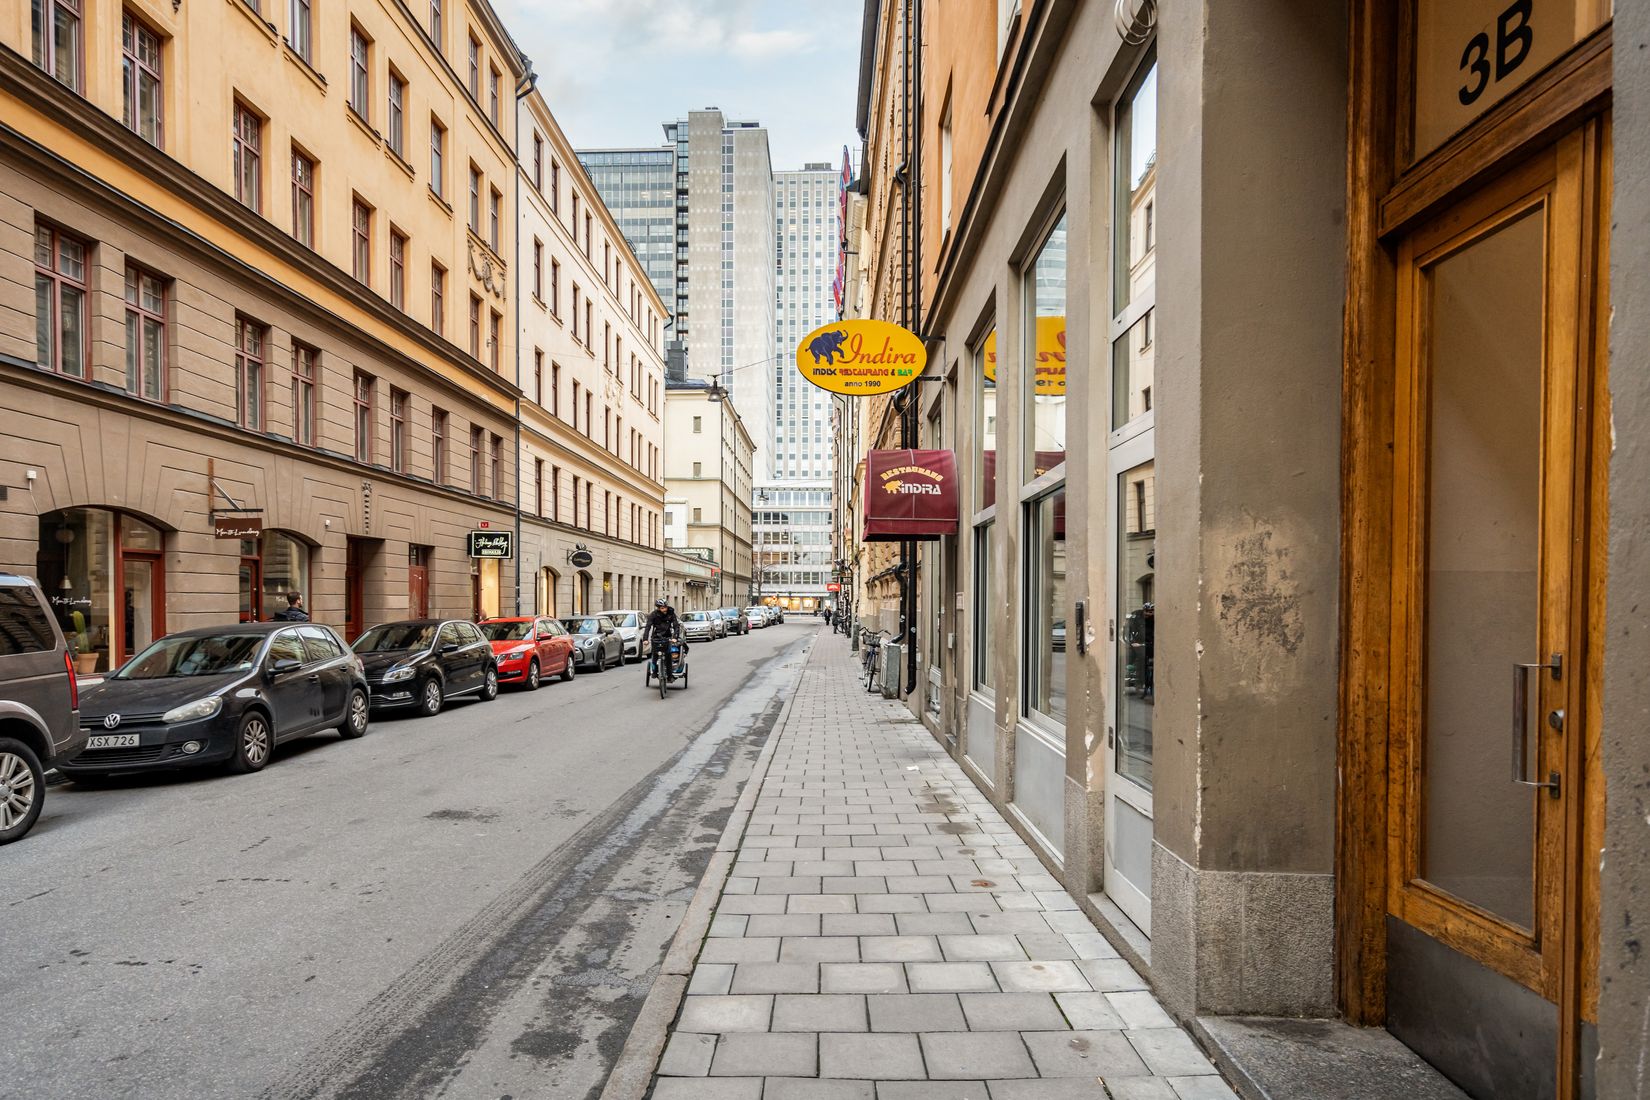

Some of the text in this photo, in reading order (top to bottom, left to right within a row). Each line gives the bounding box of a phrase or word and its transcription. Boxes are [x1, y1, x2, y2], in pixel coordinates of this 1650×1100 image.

[1458, 0, 1534, 106] 3B
[837, 332, 917, 364] Indira
[890, 368, 896, 376] &
[89, 735, 135, 748] XSX 726
